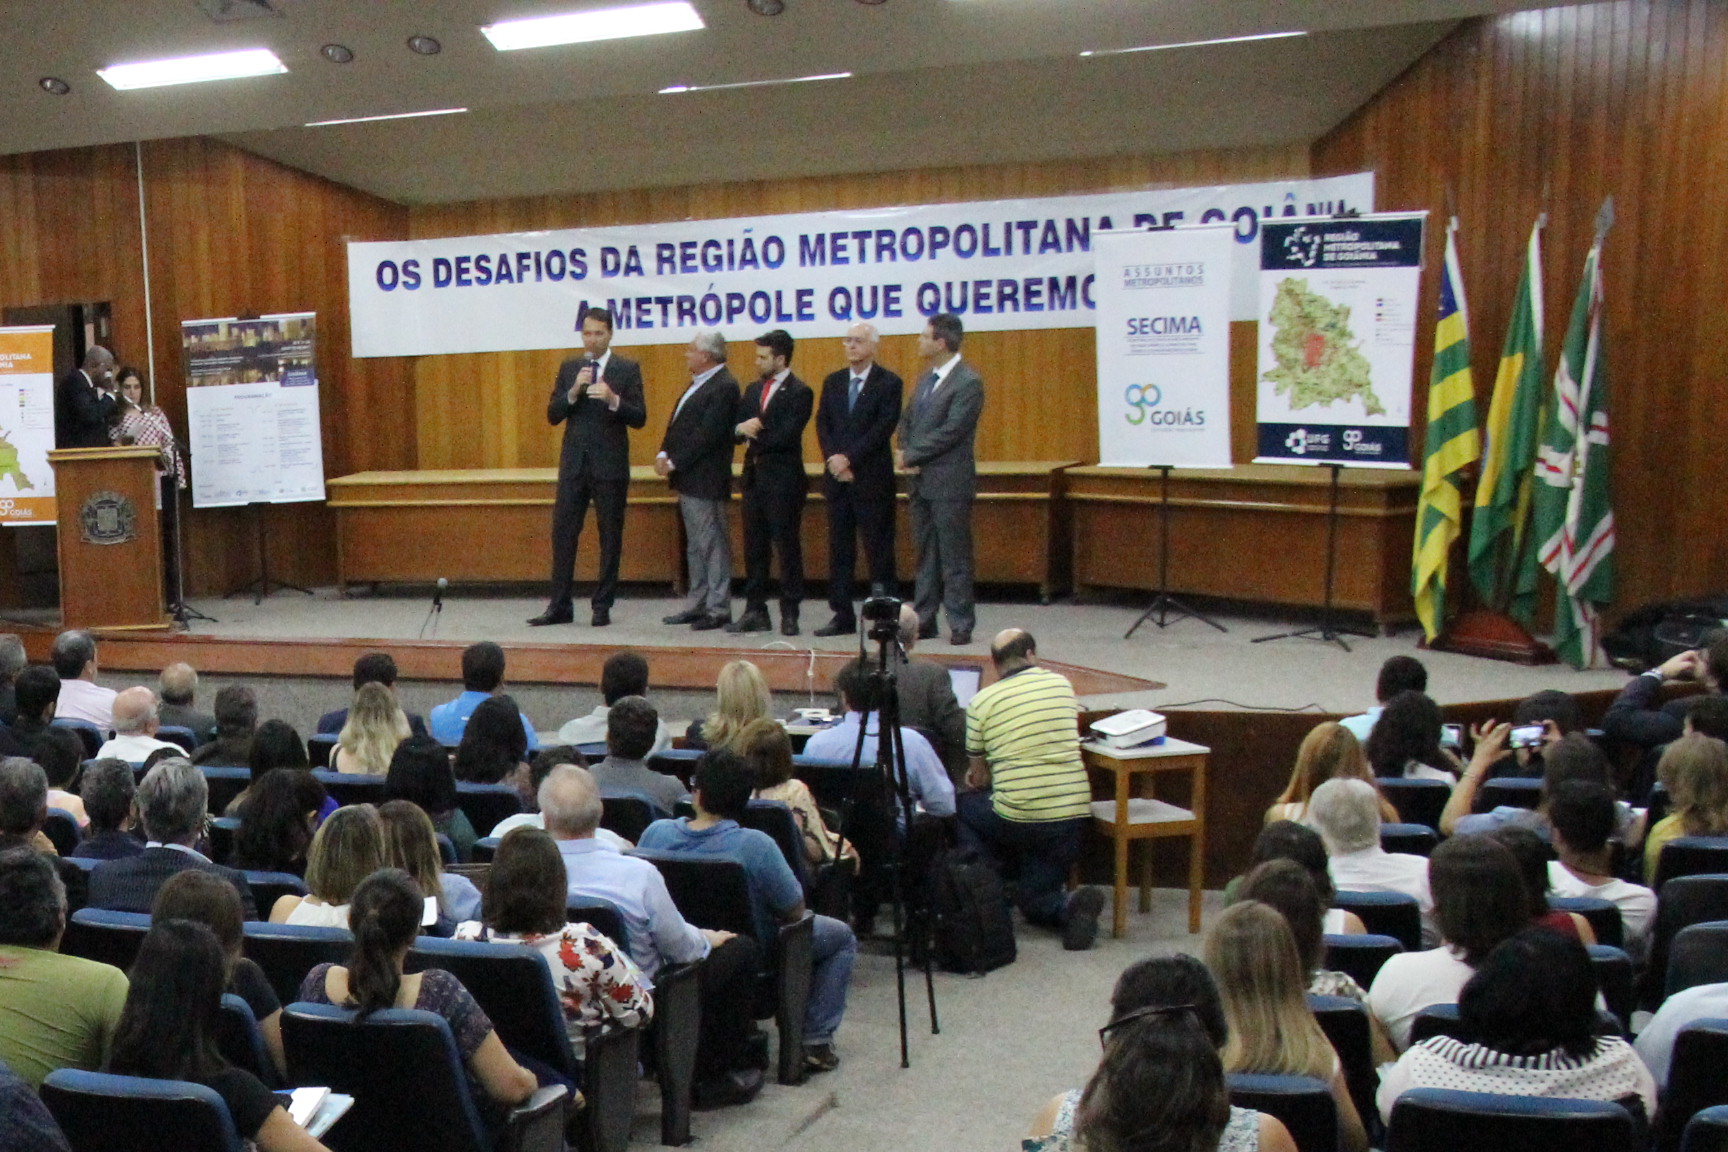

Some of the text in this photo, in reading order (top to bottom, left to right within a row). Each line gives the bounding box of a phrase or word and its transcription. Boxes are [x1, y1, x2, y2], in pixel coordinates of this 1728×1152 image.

[376, 258, 422, 292] OS
[432, 247, 589, 289] DESAFIOS
[600, 244, 645, 279] DA
[656, 227, 786, 276] REGIÃO
[1123, 264, 1204, 278] ASSUNTOS
[606, 283, 815, 330] METRÓPOLE
[828, 284, 903, 322] QUE
[915, 273, 1096, 318] QUEREMO
[1126, 316, 1202, 335] SECIMA
[1150, 407, 1205, 426] GOIÁS
